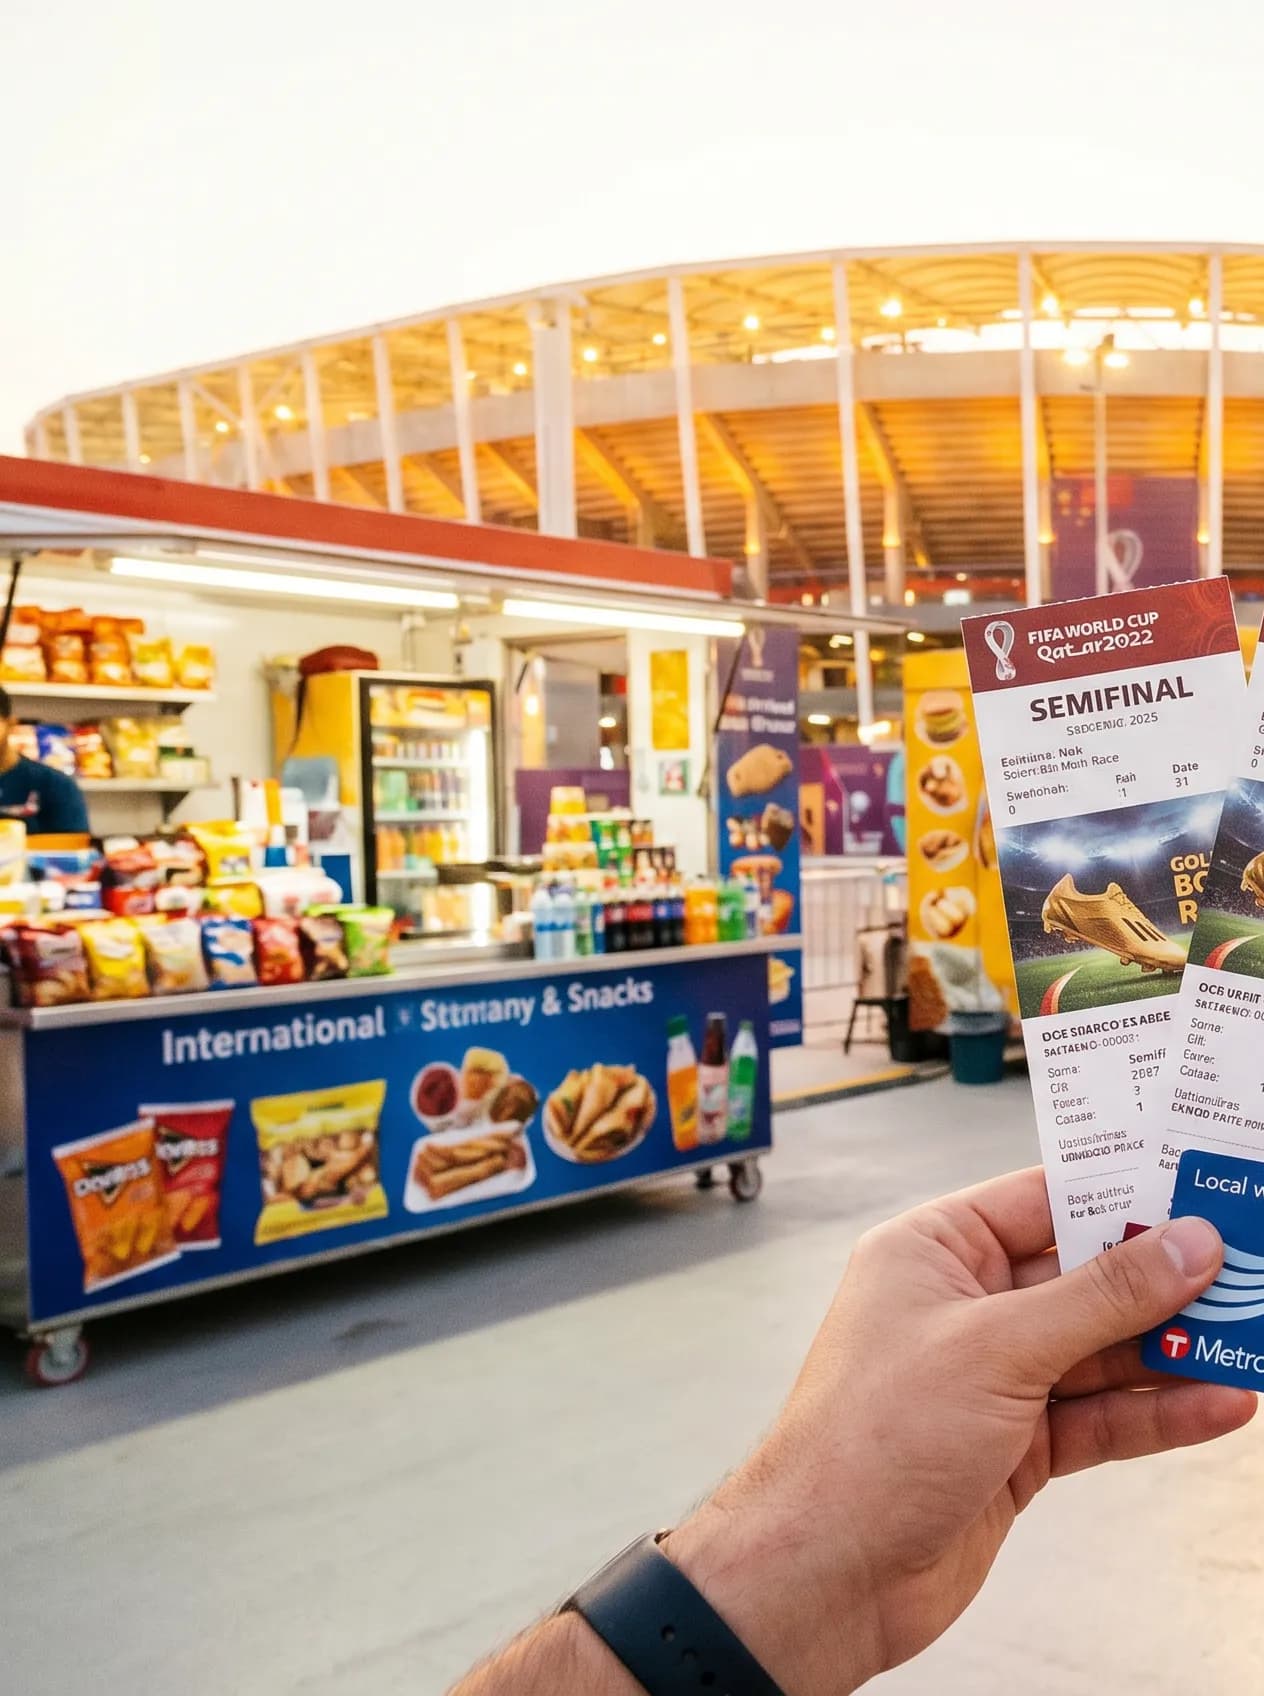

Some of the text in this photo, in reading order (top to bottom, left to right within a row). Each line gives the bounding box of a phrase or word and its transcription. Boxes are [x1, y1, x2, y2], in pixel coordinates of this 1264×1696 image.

[1028, 612, 1159, 645] FIFA WORLD CUP
[1030, 676, 1194, 721] SEMIFINAL
[1131, 712, 1159, 726] 2025
[1092, 753, 1120, 765] Race
[1172, 761, 1199, 774] Date
[1175, 777, 1189, 788] 31
[162, 1005, 386, 1065] International
[541, 985, 561, 1016] &
[567, 976, 654, 1013] Snacks
[1134, 1085, 1141, 1096] 3
[1194, 1168, 1247, 1196] Local
